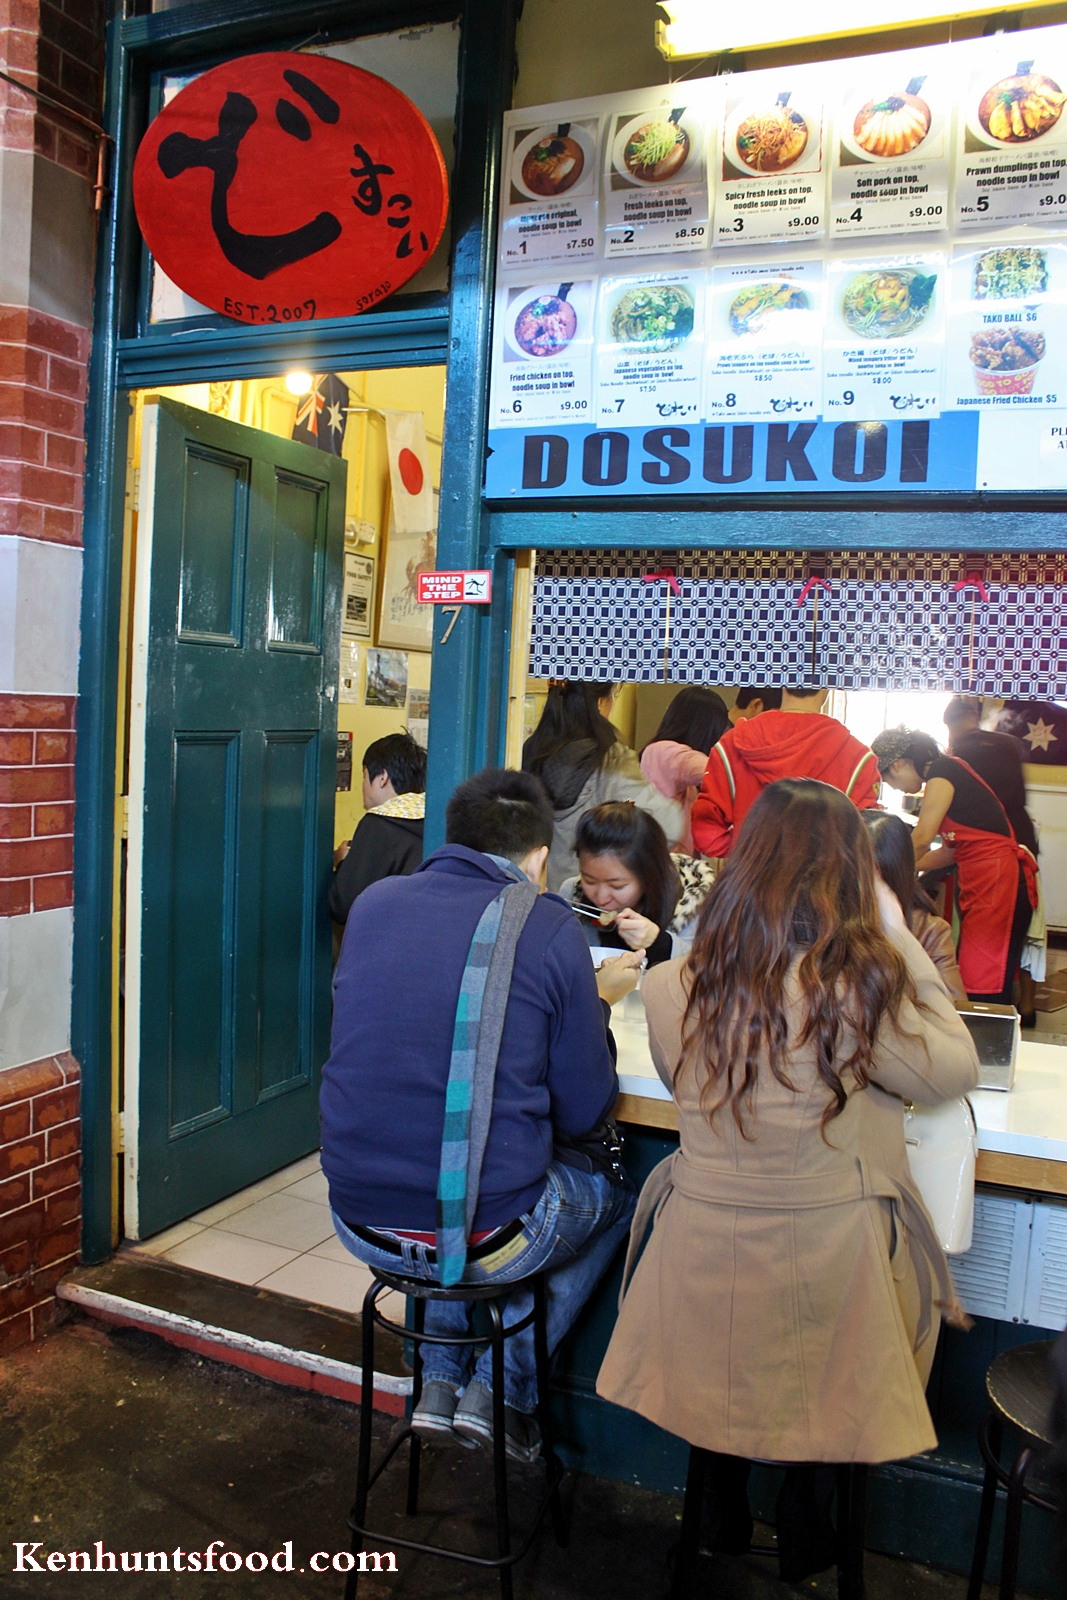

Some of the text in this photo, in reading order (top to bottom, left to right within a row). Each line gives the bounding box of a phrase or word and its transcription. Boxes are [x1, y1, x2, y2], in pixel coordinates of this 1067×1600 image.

[966, 167, 991, 176] Prawn
[993, 162, 1037, 173] dumplings
[857, 178, 872, 187] Soft
[874, 177, 891, 186] pork
[977, 171, 1060, 186] noodle soup in bowl
[725, 192, 744, 200] Spicy
[851, 189, 877, 199] noodle
[879, 189, 898, 197] soup
[909, 184, 928, 193] bowl
[625, 202, 643, 210] Fresh
[734, 201, 758, 210] noodle
[624, 212, 647, 221] noodle
[649, 211, 665, 219] soup
[675, 207, 692, 216] bowl
[910, 206, 942, 217] $9.00
[519, 224, 540, 233] noodle
[542, 222, 557, 231] soup
[566, 219, 582, 227] bowl
[788, 216, 819, 227] $9.00
[676, 228, 704, 238] $8.50
[567, 238, 594, 249] $7.50
[983, 313, 1037, 323] TAKO BALL $6
[527, 372, 552, 380] chicken
[560, 380, 575, 388] bowl
[957, 397, 990, 405] Japanese
[1046, 394, 1057, 402] $5
[561, 401, 587, 410] $9.00
[522, 420, 930, 489] DOSUKOI
[422, 576, 462, 584] MIND
[440, 606, 462, 644] 7
